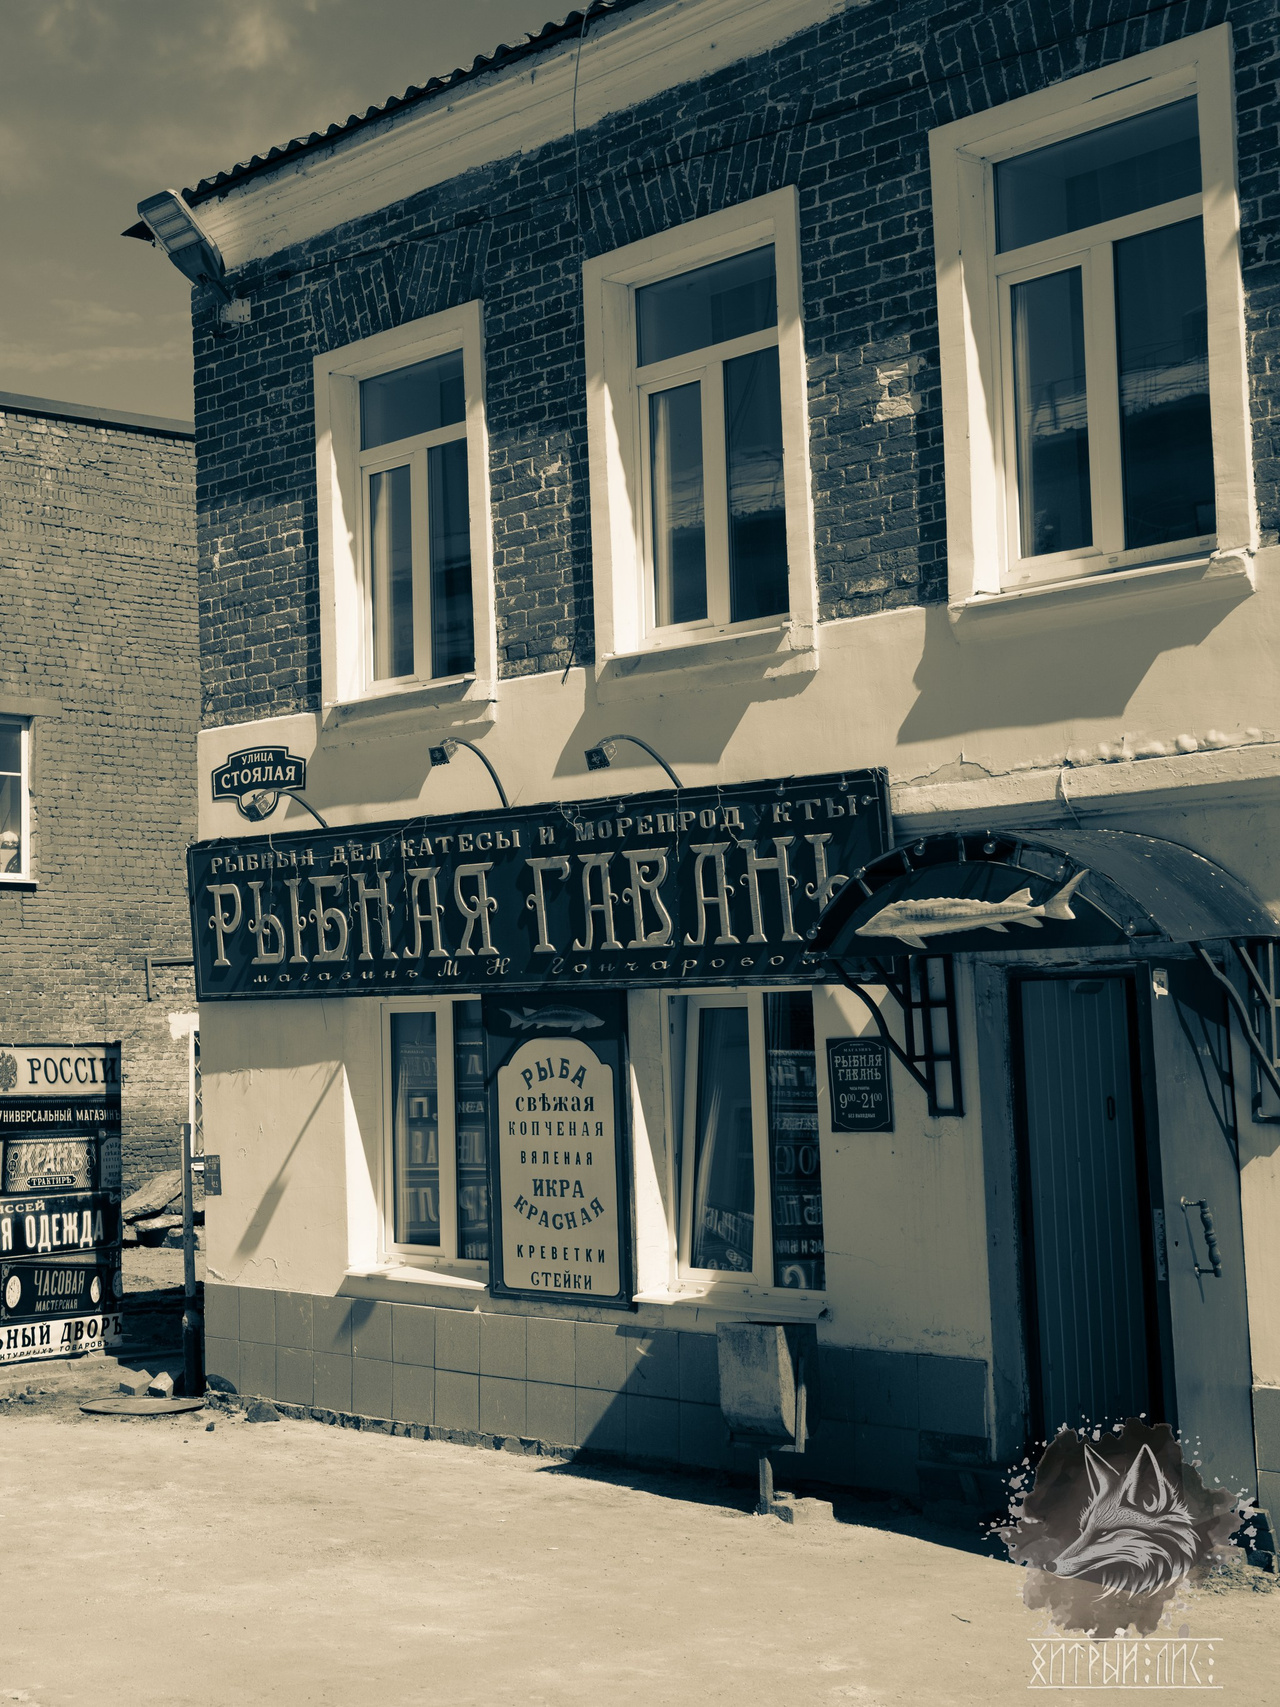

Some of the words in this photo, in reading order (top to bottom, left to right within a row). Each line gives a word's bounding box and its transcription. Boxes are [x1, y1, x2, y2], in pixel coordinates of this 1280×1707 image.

[241, 752, 274, 765] УЛИЦА
[221, 765, 296, 789] СТОЯЛАЯ
[538, 825, 556, 845] И
[205, 861, 499, 967] РЫБНАЯ
[524, 832, 850, 954] ГАВАНЬ
[26, 1057, 119, 1085] РОССІИ
[834, 1054, 883, 1068] РЫБНАЯ
[521, 1057, 587, 1090] РЫБА
[837, 1067, 882, 1081] ГАВАНЬ
[76, 1107, 120, 1121] МАГАЗИНЪ
[508, 1120, 604, 1137] КОПЧЕНАЯ
[520, 1150, 593, 1166] ВЯЛЕНАЯ
[31, 1175, 72, 1186] ТРАКТИРЪ
[532, 1178, 585, 1198] ИКРА
[513, 1195, 605, 1230] КРАСНАЯ
[24, 1209, 104, 1253] ОДЕЖДА
[516, 1244, 605, 1263] КРЕВЕТКИ
[34, 1269, 86, 1296] ЧАСОВАЯ
[530, 1270, 593, 1290] СТЕЙКИ
[35, 1298, 78, 1313] МАСТЕРСКАЯ
[60, 1315, 122, 1344] ДВОРЪ
